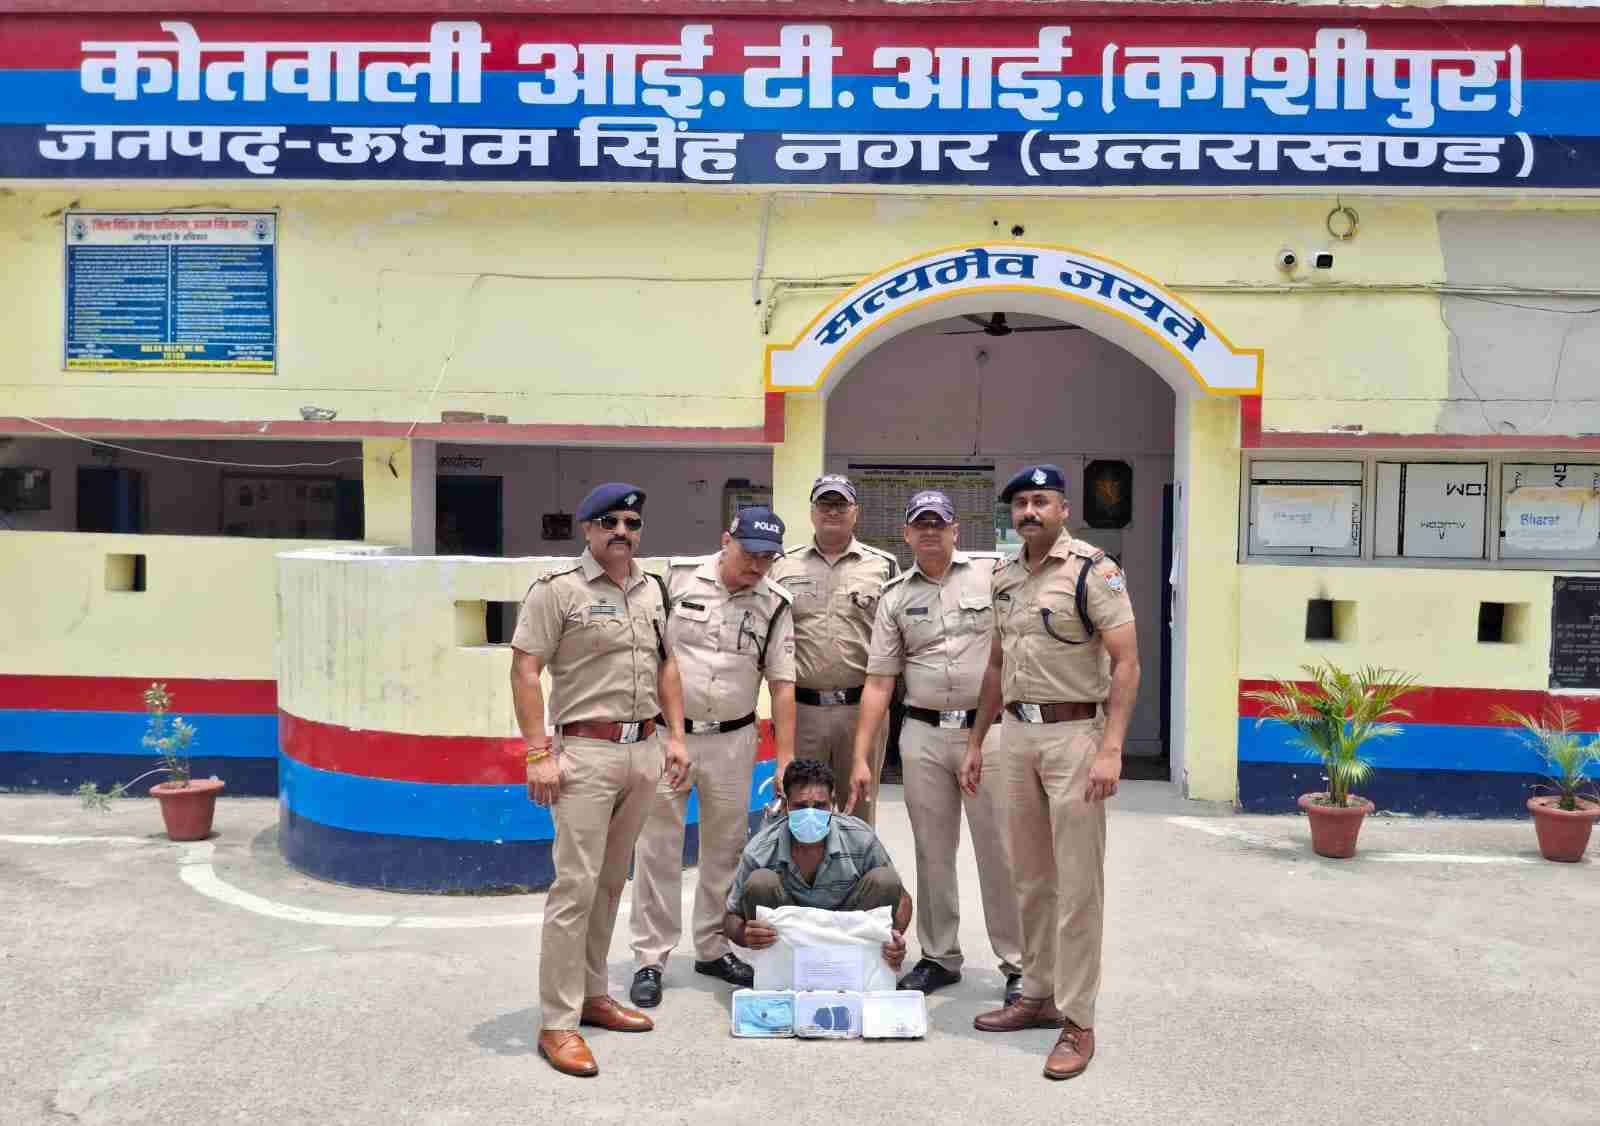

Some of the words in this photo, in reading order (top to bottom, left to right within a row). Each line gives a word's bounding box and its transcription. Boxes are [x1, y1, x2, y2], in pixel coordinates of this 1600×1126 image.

[80, 21, 491, 104] कोतवाली
[518, 24, 726, 119] आई.
[743, 25, 854, 109] टी.
[872, 26, 1083, 121] आई.
[1102, 28, 1522, 129] (काशीपुर)
[39, 124, 558, 175] जनपद-ऊधम
[573, 116, 745, 182] सिंह
[775, 133, 998, 172] नगर
[1020, 129, 1534, 178] (उत्तराखण्ड)
[814, 248, 1039, 346] सत्यमेव
[1060, 259, 1207, 353] जयते
